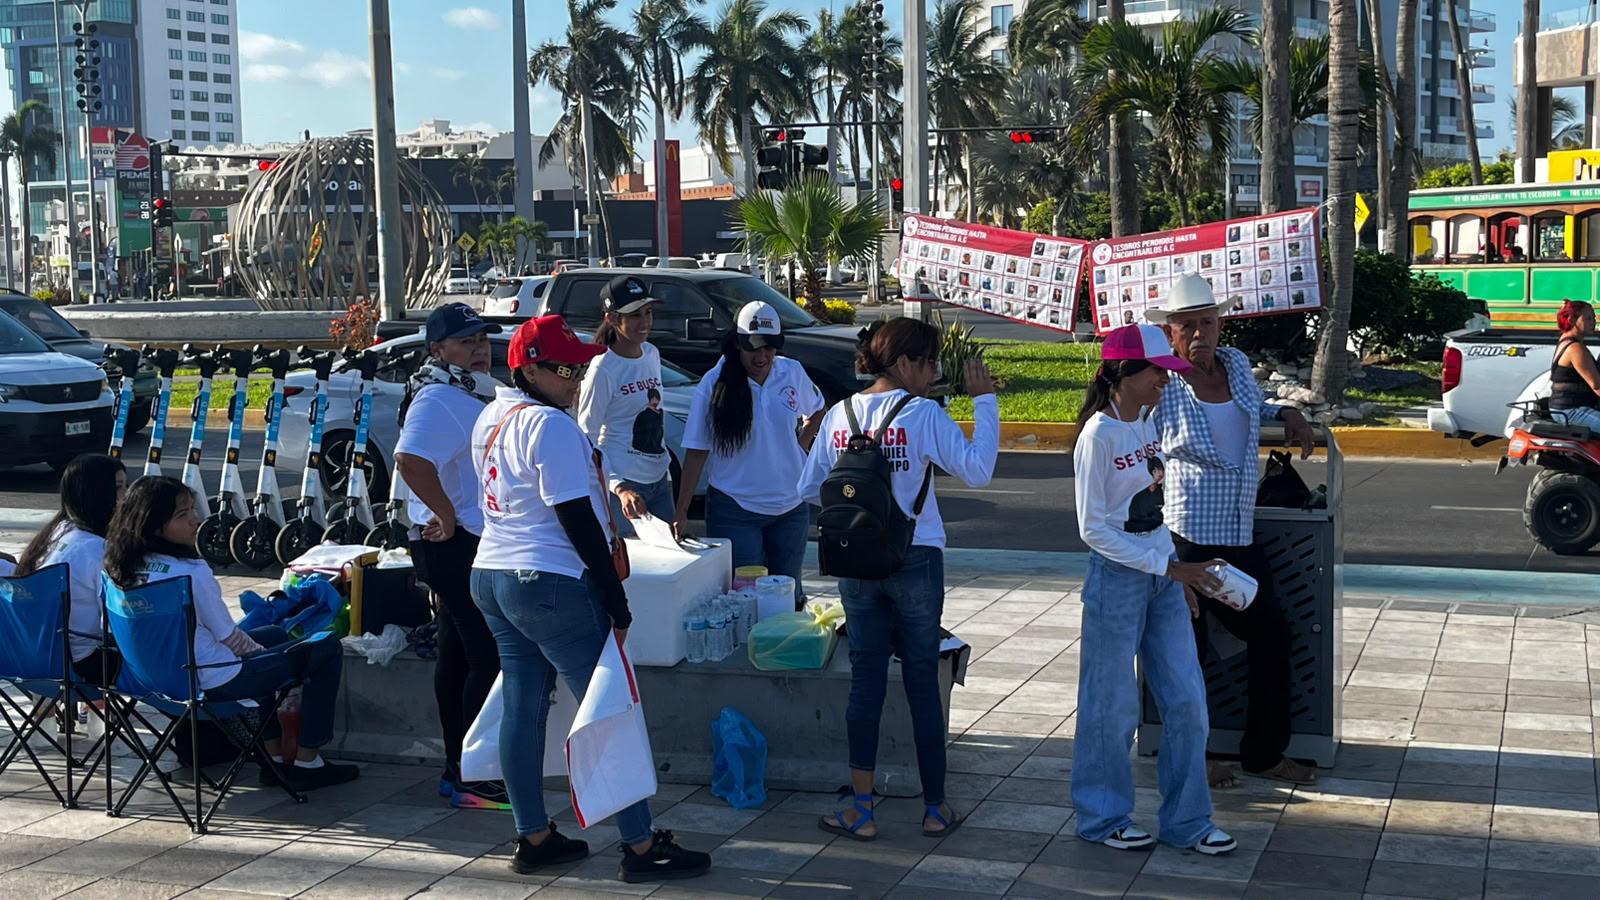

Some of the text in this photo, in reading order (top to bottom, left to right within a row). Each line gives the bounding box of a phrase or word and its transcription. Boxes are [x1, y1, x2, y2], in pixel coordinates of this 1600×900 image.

[120, 171, 150, 179] PEME
[918, 220, 942, 231] TESOROS
[968, 230, 988, 240] HASTA
[1112, 232, 1198, 252] TESOROS PERDIDOS HASTA
[1112, 246, 1162, 260] ENCONTRARLOS
[1468, 345, 1531, 358] PRO-4X
[620, 377, 662, 396] SE BUSC
[833, 430, 849, 448] SE
[1113, 440, 1162, 471] SE BUSC
